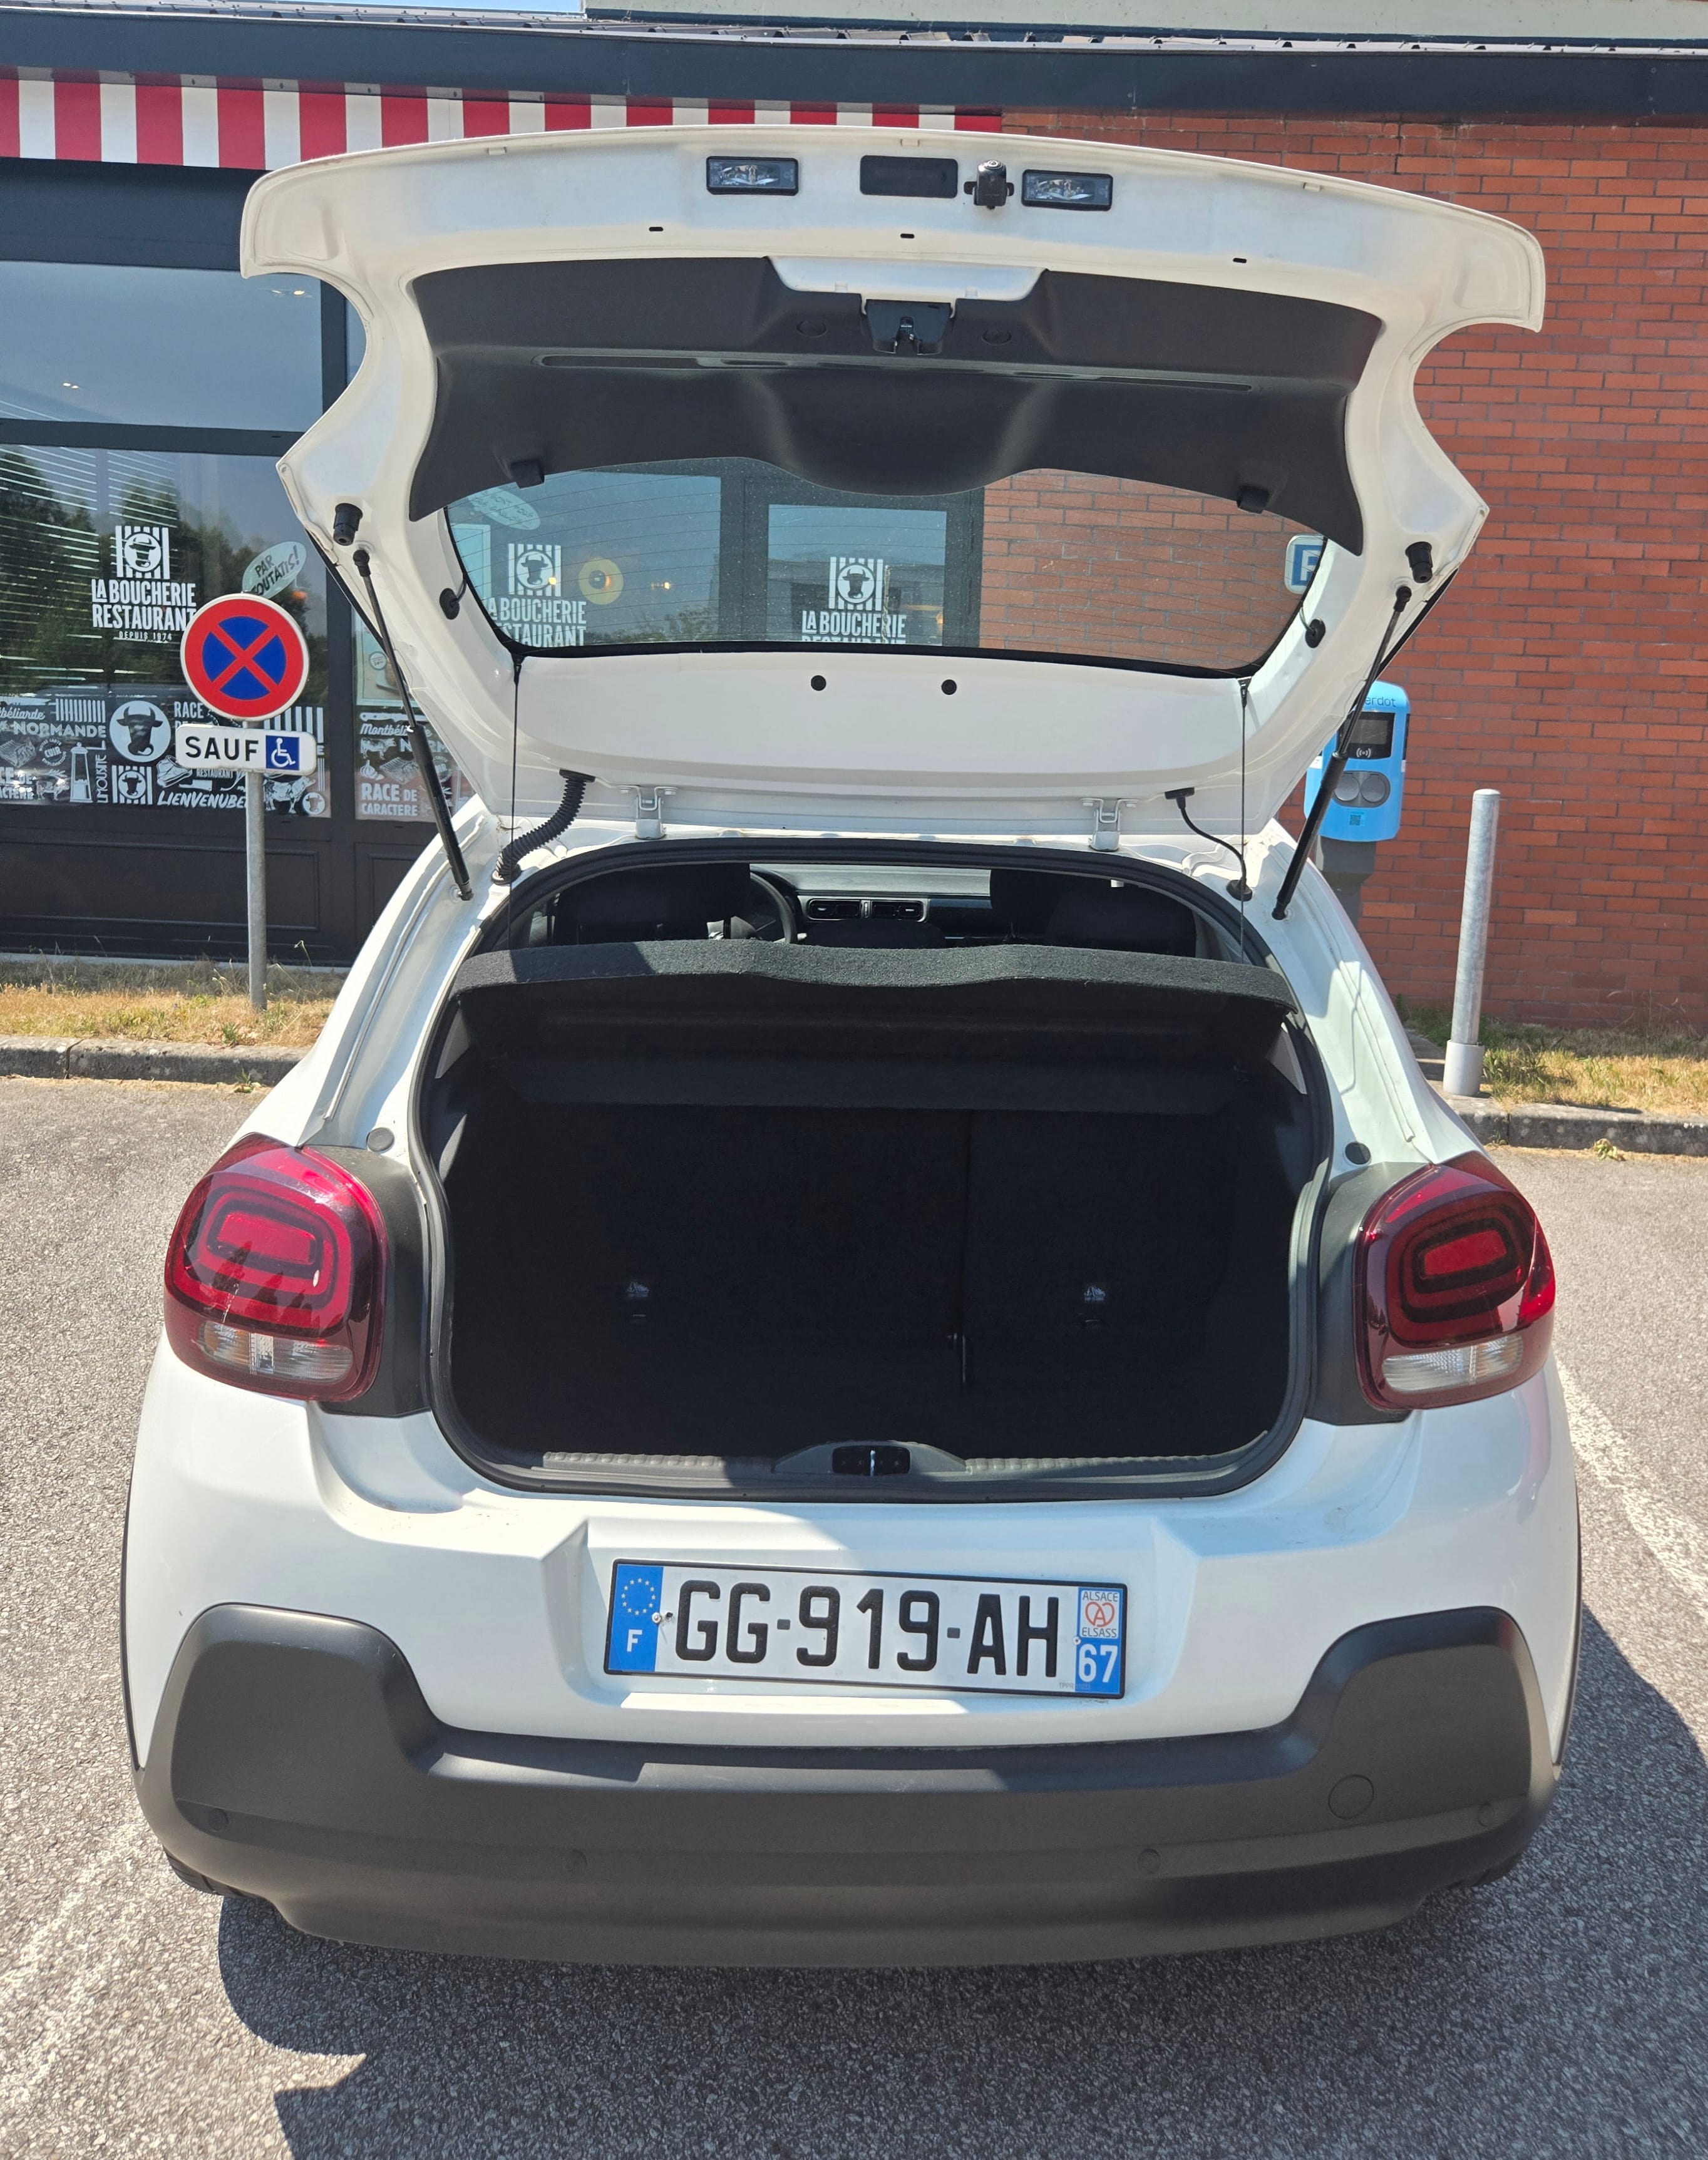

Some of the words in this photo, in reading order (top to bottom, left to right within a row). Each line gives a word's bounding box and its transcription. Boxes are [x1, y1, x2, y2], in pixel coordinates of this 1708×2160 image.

[255, 555, 274, 577] PAR
[91, 579, 107, 602] LA
[109, 580, 196, 607] BOUCHERIE
[93, 604, 197, 631] RESTAURANT
[485, 597, 497, 620] A
[500, 597, 587, 624] BOUCHERIE
[802, 610, 816, 634] LA
[820, 611, 907, 637] BOUCHERIE
[119, 631, 148, 639] DEPUIS
[497, 622, 587, 647] STAURANT
[174, 701, 203, 718] RACE
[1365, 697, 1396, 707] erdot
[13, 721, 106, 738] NORMANDE
[185, 736, 259, 761] SAUF
[157, 789, 246, 808] LIENVENUBE
[361, 783, 399, 801] RACE
[404, 789, 418, 801] DE
[361, 803, 418, 816] CARACTERE
[1082, 1591, 1118, 1602] ALSACE
[627, 1630, 642, 1652] F
[675, 1580, 1058, 1678] GG-919-AH
[1078, 1643, 1118, 1683] 67
[1081, 1627, 1117, 1638] ELSASS
